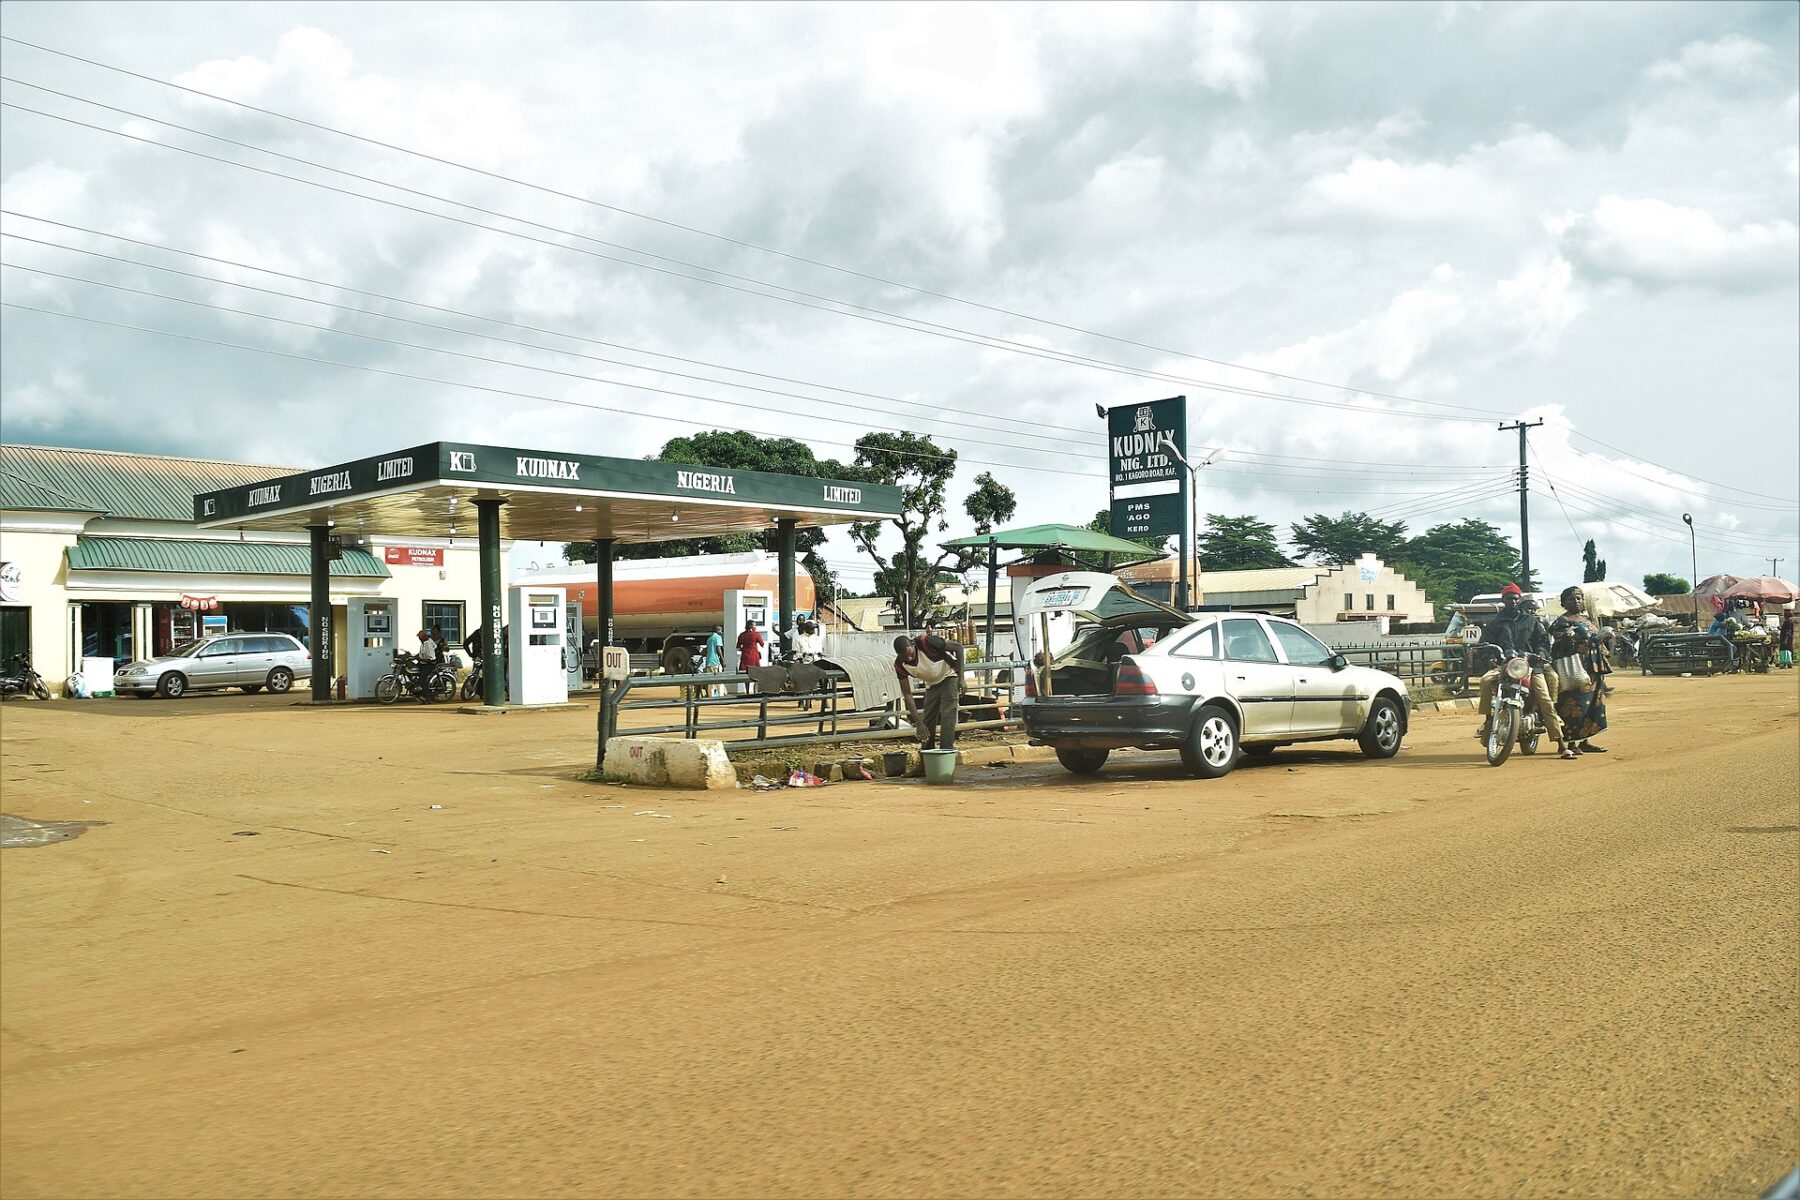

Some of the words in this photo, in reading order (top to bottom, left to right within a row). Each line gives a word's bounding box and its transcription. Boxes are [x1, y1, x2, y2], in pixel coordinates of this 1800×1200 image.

[1141, 418, 1146, 426] K
[1120, 457, 1143, 472] NIG.
[1147, 454, 1172, 468] LTD.
[248, 484, 282, 507] KUDNAX
[309, 471, 352, 495] NIGERIA
[377, 457, 413, 482] LIMITED
[516, 456, 580, 480] KUDNAX
[676, 470, 736, 494] NIGERIA
[823, 485, 862, 504] LIMITED
[1127, 503, 1150, 512] PMS
[1128, 513, 1150, 521] AGO
[408, 548, 437, 557] KUDNAX
[493, 605, 501, 618] NO
[321, 616, 329, 627] NO
[1465, 630, 1477, 638] IN
[321, 627, 329, 660] SMOKING
[606, 652, 622, 668] OUT
[630, 746, 643, 758] OUT
